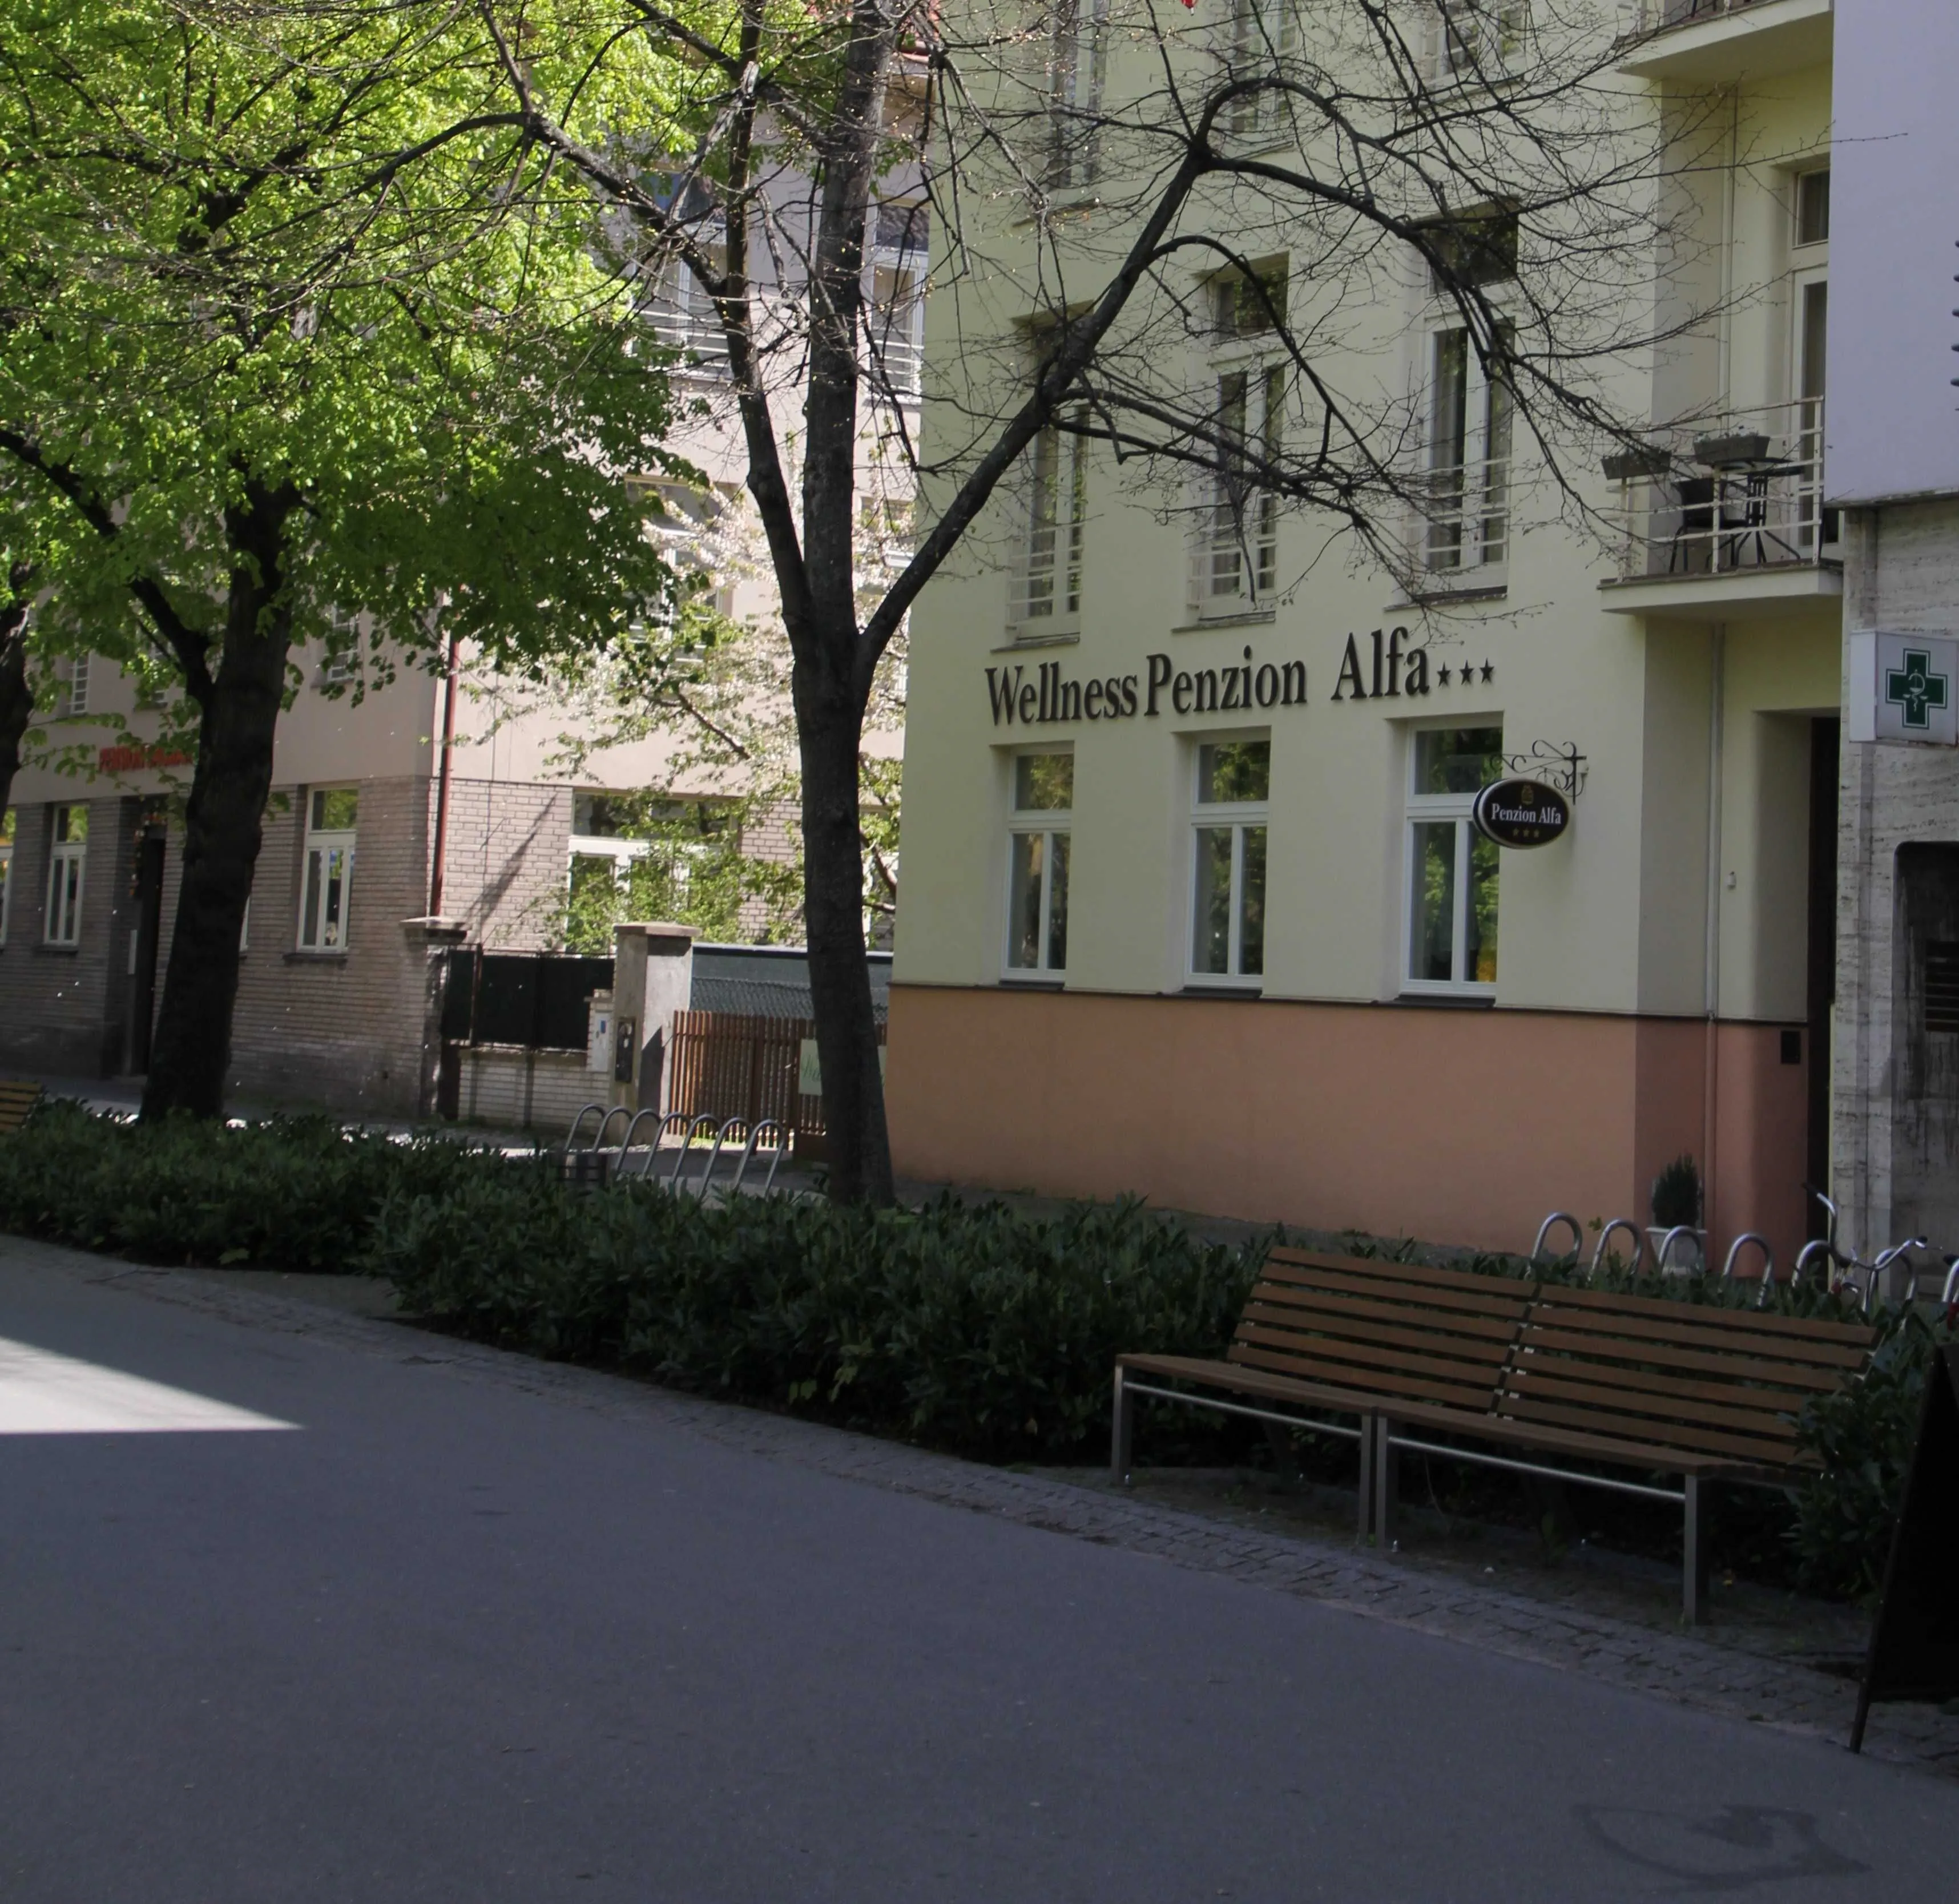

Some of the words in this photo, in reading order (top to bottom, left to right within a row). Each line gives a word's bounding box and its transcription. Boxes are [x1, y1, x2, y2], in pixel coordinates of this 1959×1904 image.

[985, 660, 1138, 727] Wellness
[1143, 644, 1307, 717] Penzion
[1330, 626, 1430, 701] Alfa
[1491, 802, 1536, 822] Penzion
[1538, 806, 1562, 825] Alfa
